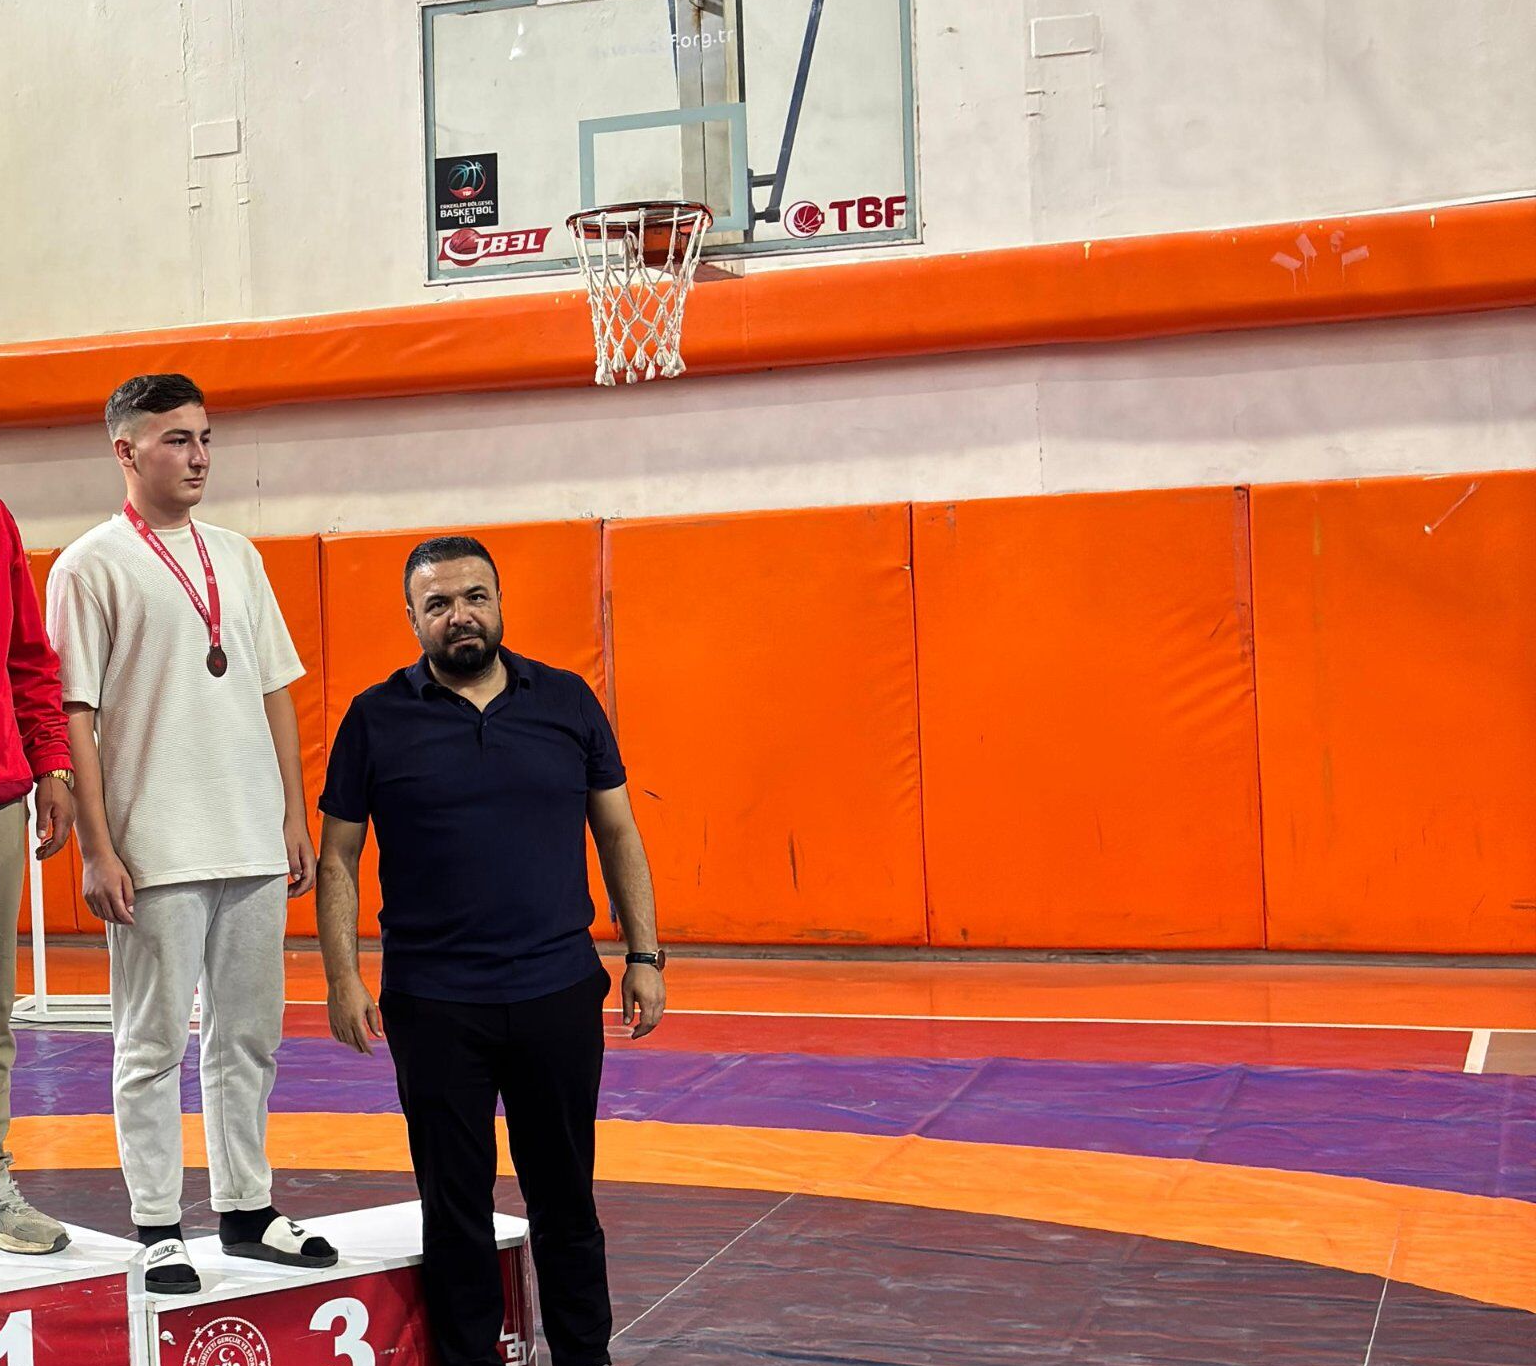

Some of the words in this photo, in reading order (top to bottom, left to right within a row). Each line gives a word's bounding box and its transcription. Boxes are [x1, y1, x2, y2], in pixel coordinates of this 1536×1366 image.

[440, 206, 495, 218] BASKETBOL
[829, 195, 907, 232] TBF
[150, 1243, 180, 1259] NIKE
[216, 1336, 241, 1345] GENÇLİK
